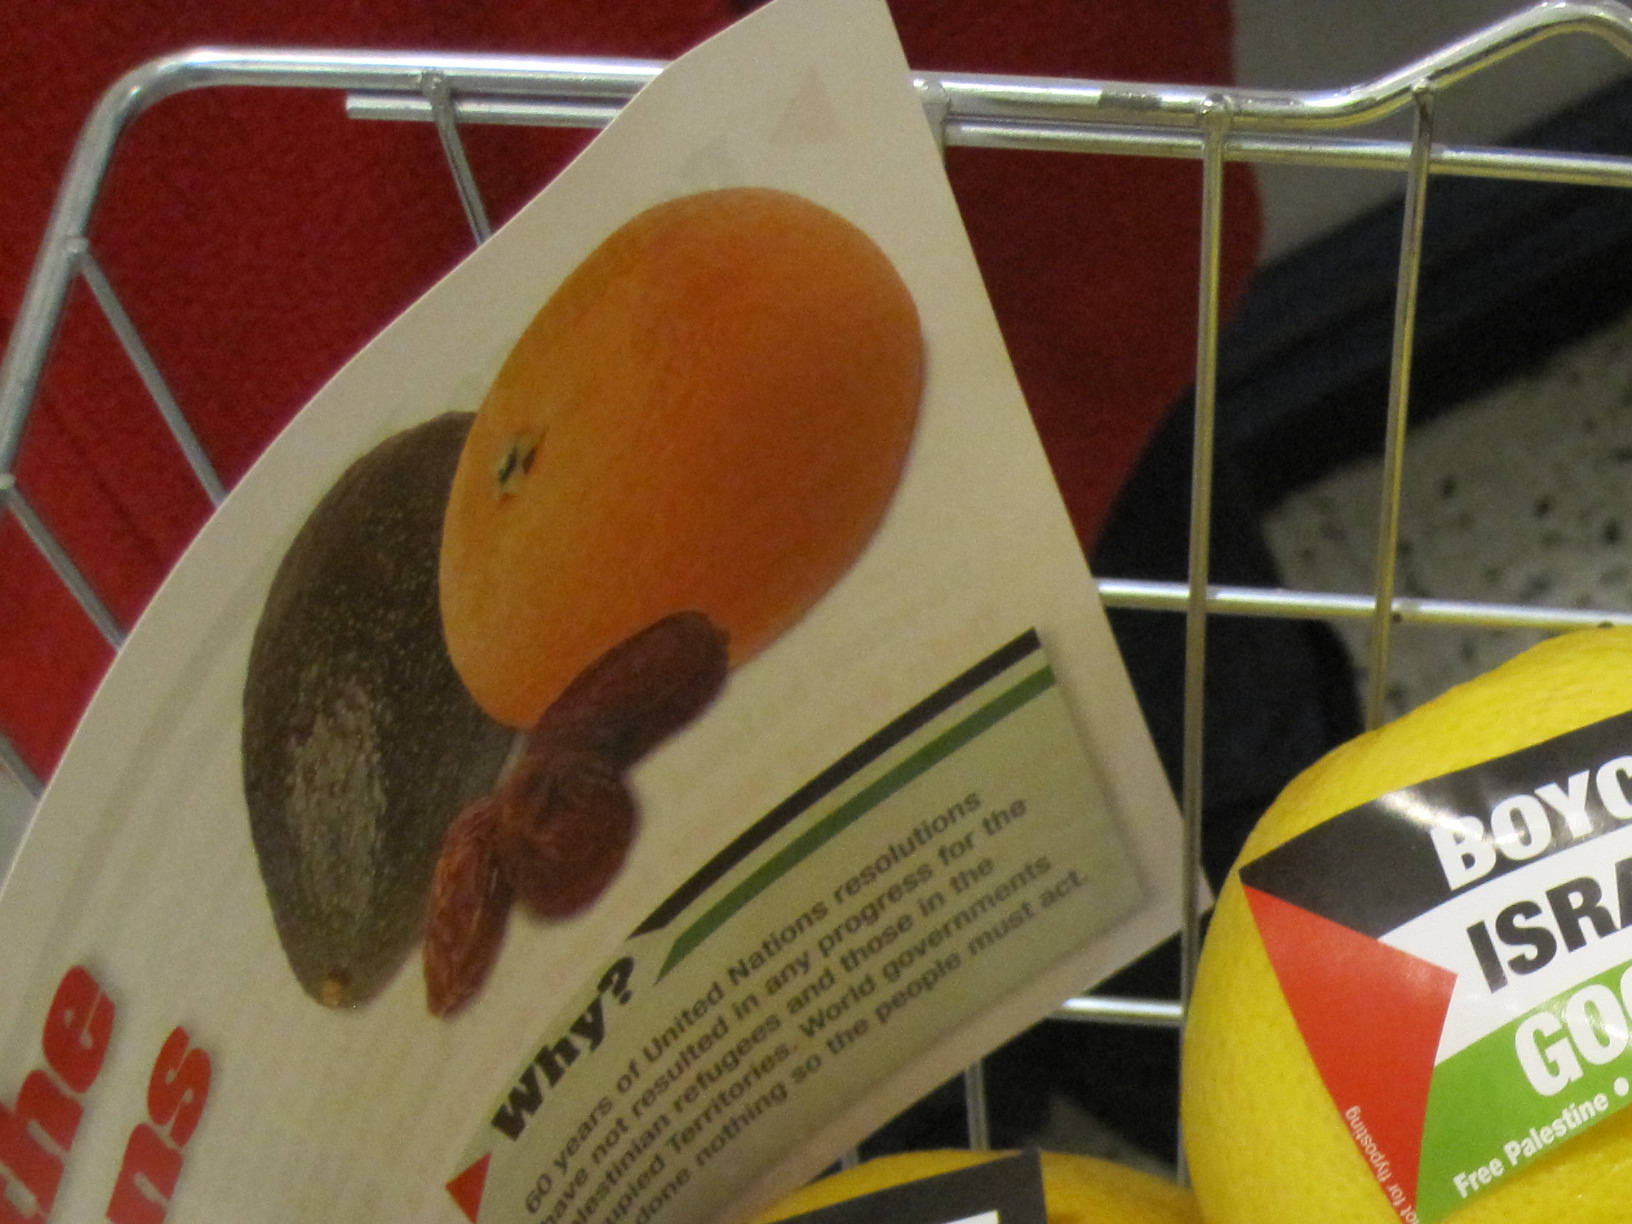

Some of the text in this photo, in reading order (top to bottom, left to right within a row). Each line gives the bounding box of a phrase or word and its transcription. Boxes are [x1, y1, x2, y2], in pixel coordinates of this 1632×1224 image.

[491, 956, 636, 1142] Why?
[525, 791, 982, 1215] 60 years of United Nations resolutions
[591, 1119, 629, 1163] not
[631, 1019, 730, 1120] resulted
[734, 993, 759, 1022] in
[763, 952, 819, 997] any
[816, 862, 934, 959] progress
[938, 831, 975, 866] for
[981, 798, 1028, 838] the
[667, 1043, 799, 1154] Territories.
[799, 973, 876, 1038] World
[881, 855, 1052, 983] governments
[673, 1014, 781, 1114] refugees
[785, 969, 836, 1015] and
[840, 912, 914, 973] those
[918, 886, 946, 917] in
[949, 856, 994, 894] the
[696, 1081, 789, 1167] nothing
[790, 1053, 823, 1085] so
[826, 1017, 870, 1056] the
[874, 951, 963, 1025] people
[966, 903, 1036, 956] must
[1039, 869, 1090, 908] act.
[1345, 1105, 1393, 1183] flyposting
[1386, 1183, 1407, 1207] for
[1452, 1157, 1504, 1198] Free
[1503, 1089, 1610, 1166] Palestine
